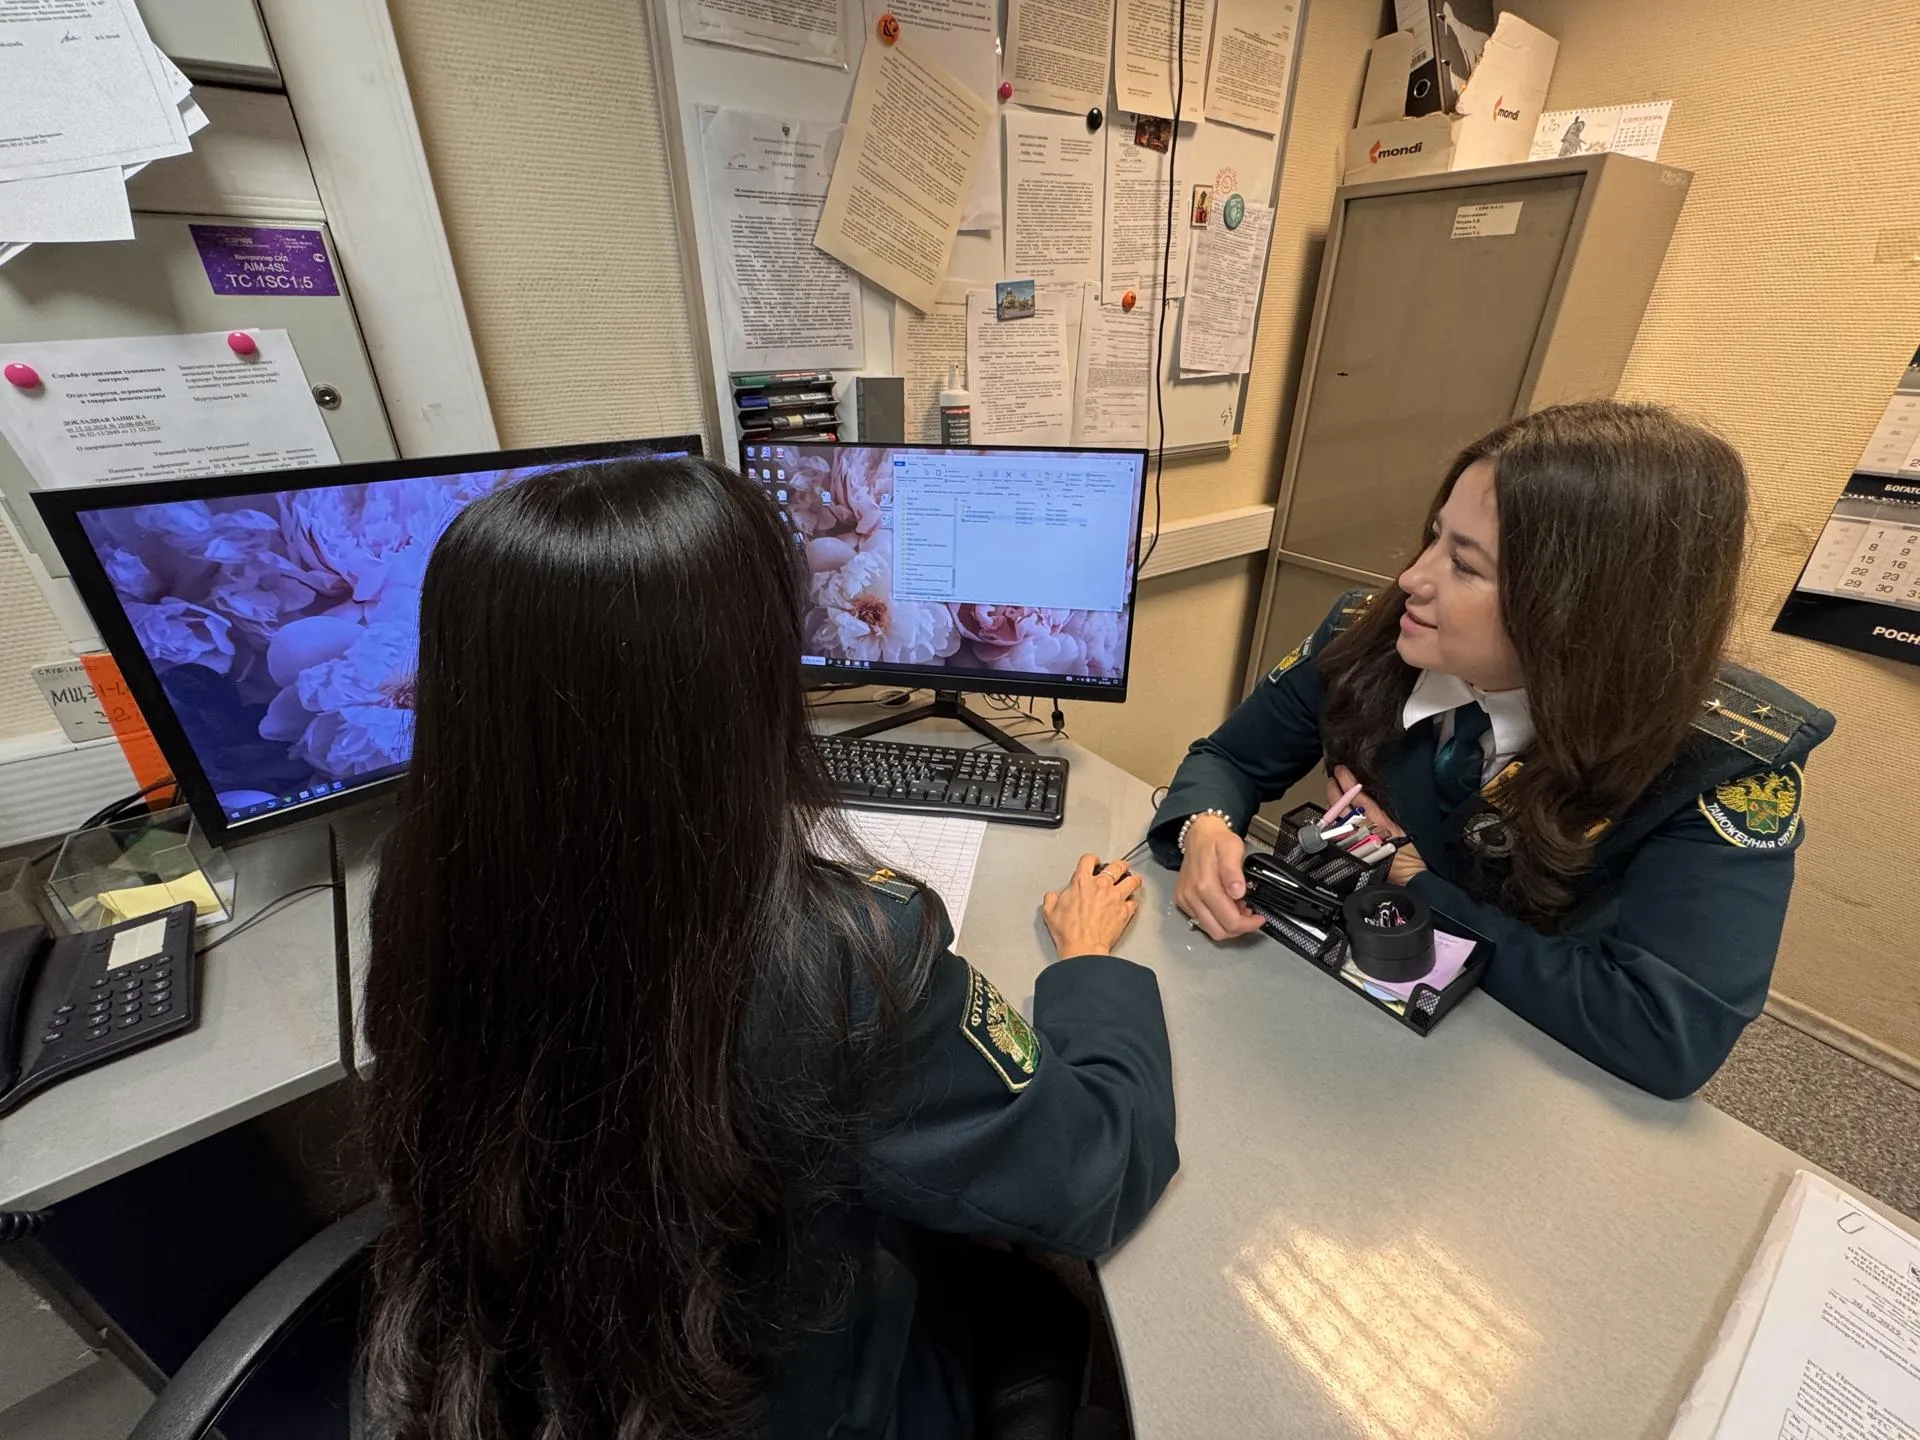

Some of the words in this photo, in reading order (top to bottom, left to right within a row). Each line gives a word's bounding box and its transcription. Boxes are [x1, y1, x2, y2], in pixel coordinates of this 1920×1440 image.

[1498, 108, 1520, 121] mondi
[1378, 142, 1423, 159] mondi
[243, 263, 290, 272] AIM-4SL
[52, 371, 79, 380] Служба
[63, 417, 110, 426] ДОКЛАДНАЯ
[111, 414, 147, 422] ЗАПИСКА
[1878, 531, 1884, 539] 1
[1907, 535, 1918, 544] 2
[1868, 543, 1879, 552] 8
[1900, 548, 1911, 556] 9
[1860, 555, 1877, 564] 15
[1890, 560, 1908, 570] 16
[1851, 567, 1869, 576] 22
[1882, 572, 1900, 581] 23
[1844, 579, 1862, 588] 29
[1875, 584, 1894, 594] 30
[1872, 626, 1920, 646] РОСН
[1706, 803, 1776, 849] ТАМОЖЕННАЯ
